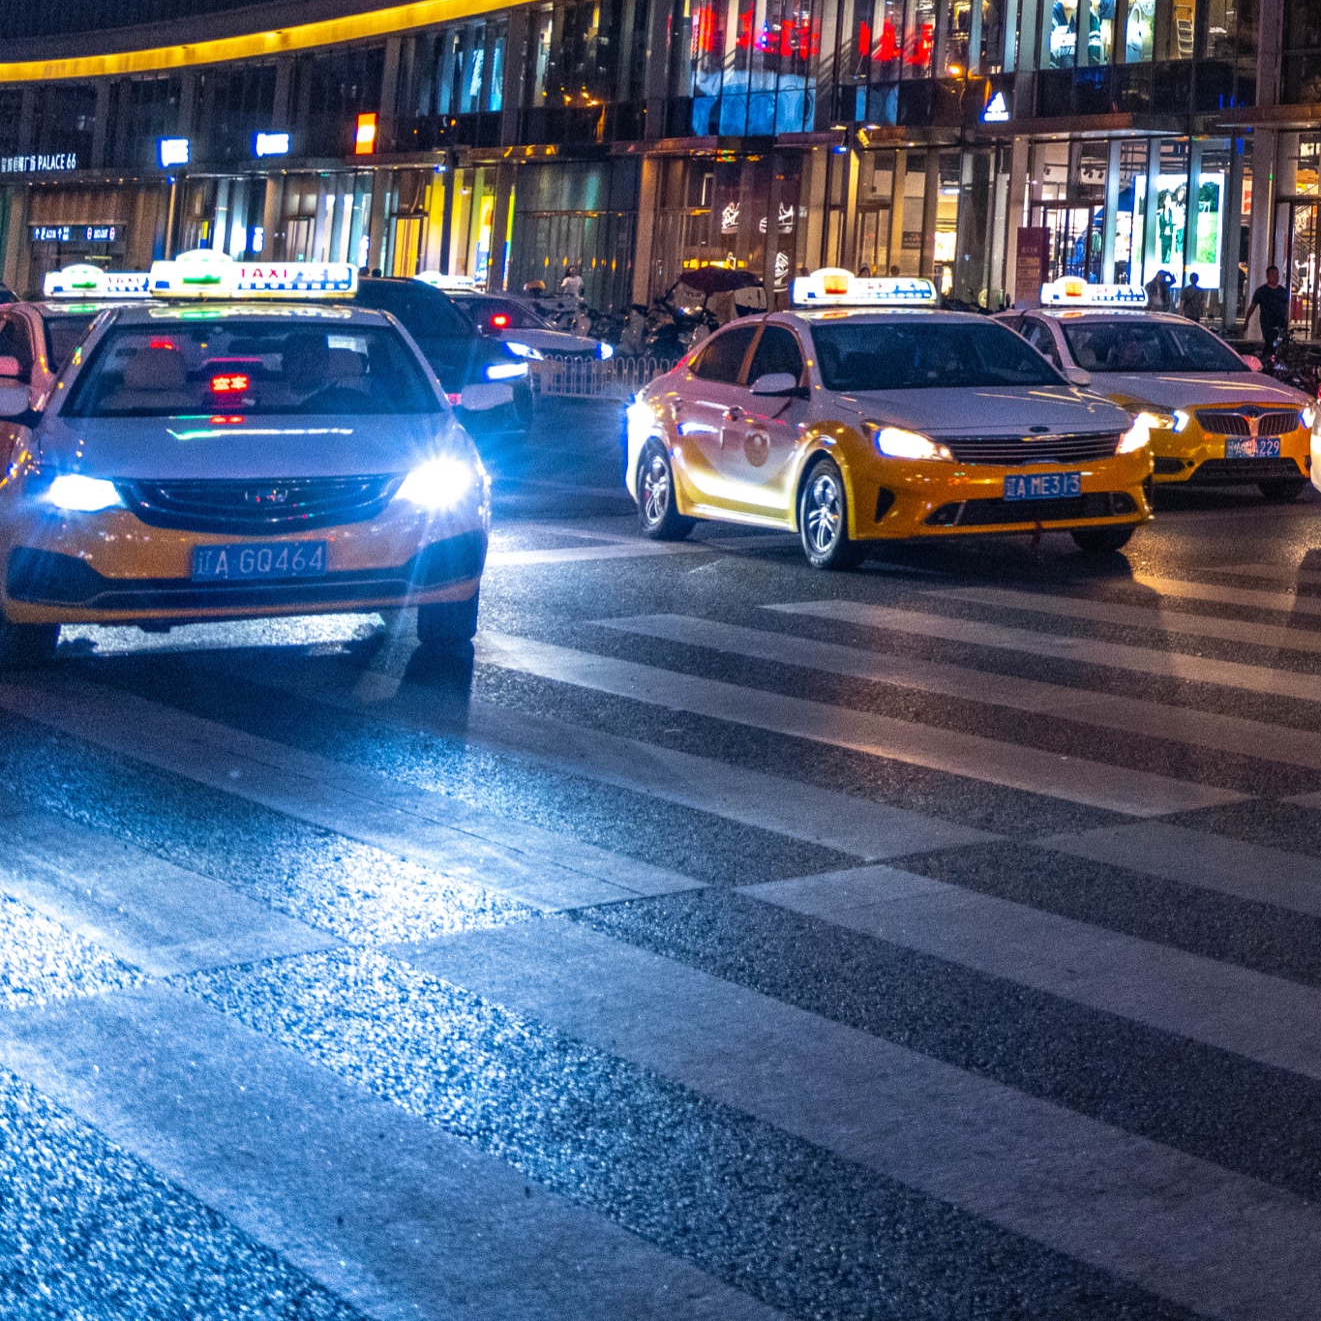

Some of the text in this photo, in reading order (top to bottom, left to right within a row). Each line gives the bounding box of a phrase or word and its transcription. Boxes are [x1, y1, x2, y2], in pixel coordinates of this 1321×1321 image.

[38, 154, 65, 170] PALACE
[66, 153, 76, 169] 66
[213, 376, 248, 390] 空车
